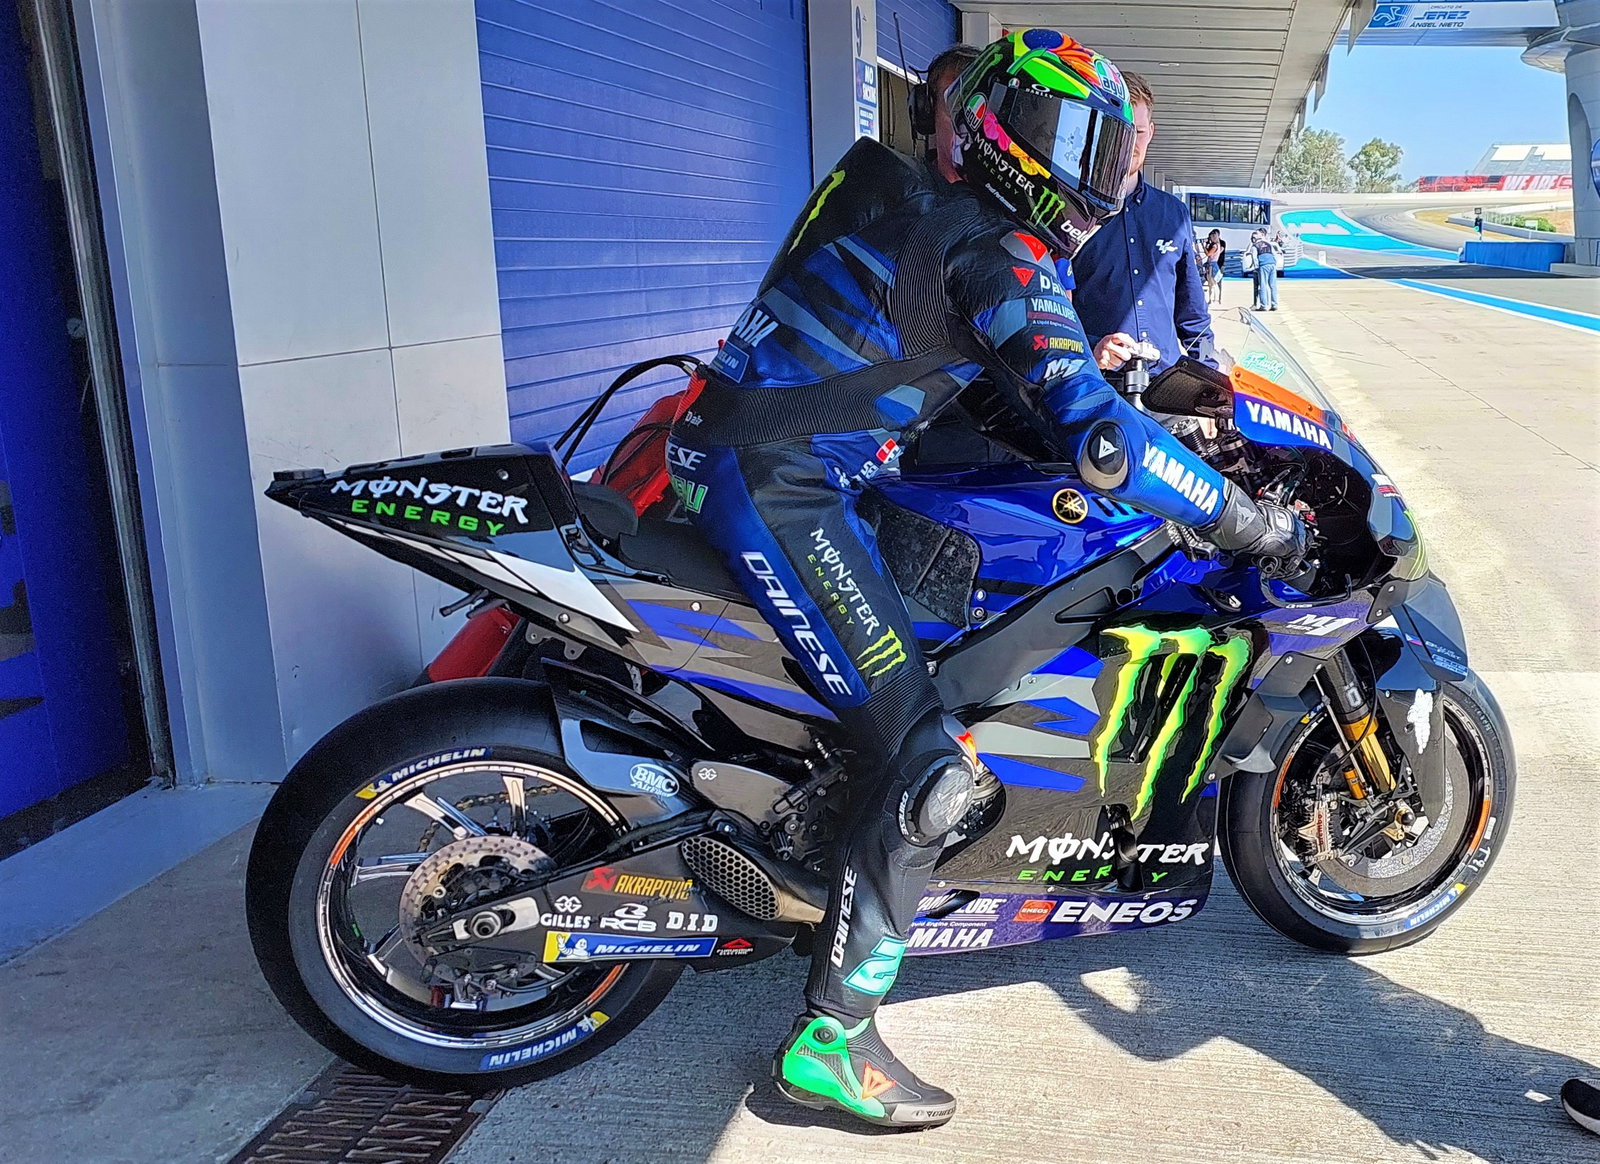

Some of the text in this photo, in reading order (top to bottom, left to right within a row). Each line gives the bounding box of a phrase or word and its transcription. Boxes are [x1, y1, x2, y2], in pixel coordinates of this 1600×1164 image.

[1413, 10, 1471, 20] JEREZ
[1025, 88, 1053, 99] OAKLEY
[1503, 175, 1528, 191] WE
[1031, 298, 1077, 322] YAMALUBE
[734, 305, 779, 348] AHA
[1245, 400, 1333, 450] YAMAHA
[1143, 441, 1220, 516] YAMAHA
[351, 499, 505, 537] ENERGY
[807, 553, 855, 626] ENERGY
[741, 551, 853, 696] DAINESE
[392, 747, 487, 781] MICHELIN
[633, 765, 676, 792] BMC
[1017, 864, 1169, 883] ENERY
[540, 913, 592, 929] GILLES
[665, 911, 719, 932] D.I.D
[830, 865, 858, 969] DAINESE
[1020, 899, 1198, 924] ENEOS ENEOS
[1409, 894, 1452, 927] MICHELIN
[599, 917, 657, 932] RCB
[594, 944, 701, 954] MICHELIN
[906, 928, 994, 948] MAHA
[488, 1026, 578, 1067] MICHELIN
